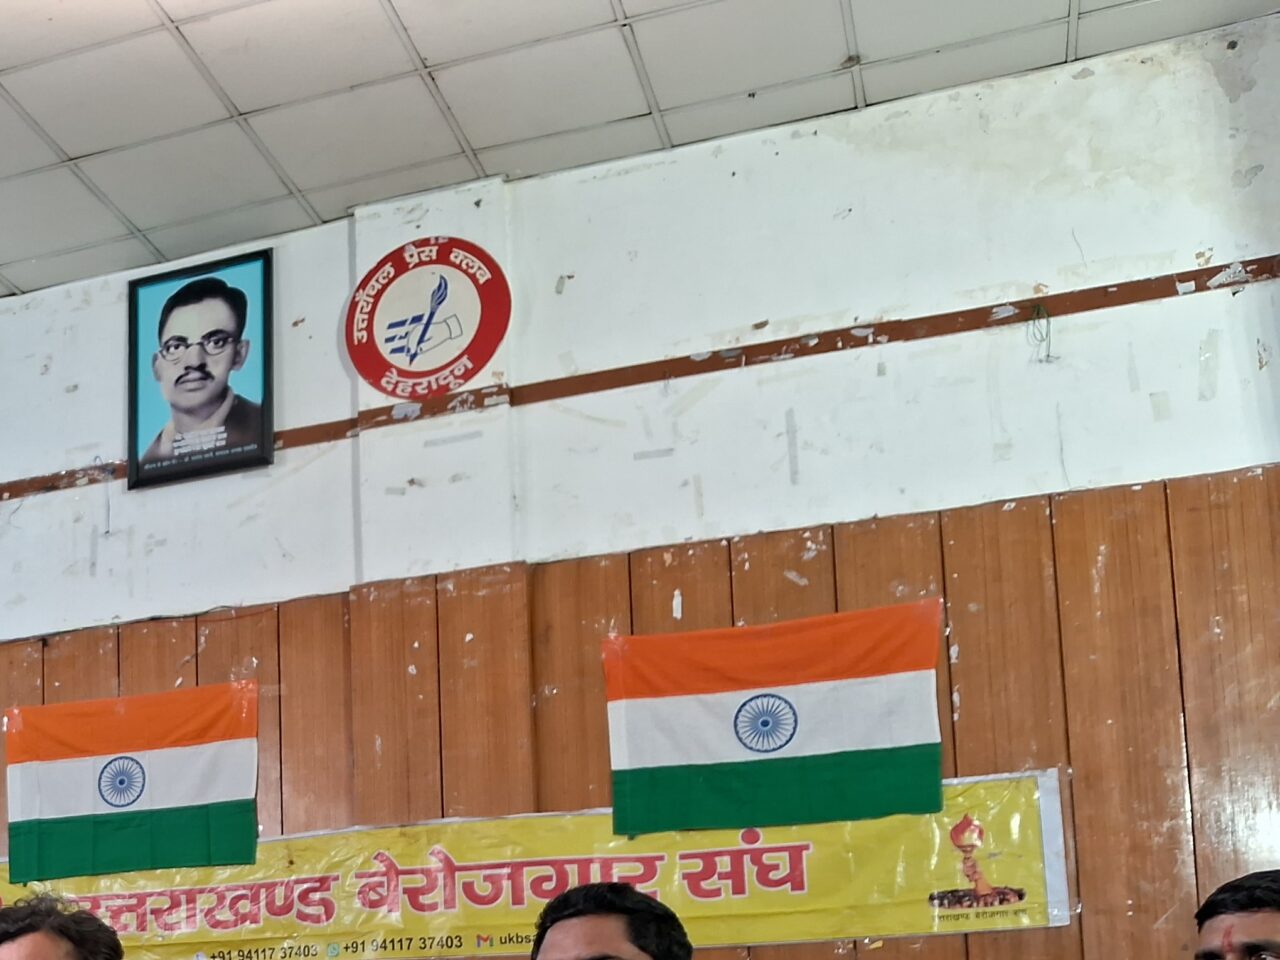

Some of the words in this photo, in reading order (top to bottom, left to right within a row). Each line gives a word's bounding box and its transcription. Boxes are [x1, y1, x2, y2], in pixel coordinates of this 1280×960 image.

[449, 248, 492, 285] क्लब
[380, 355, 474, 396] देहरादून
[354, 846, 666, 914] बेरोजगार
[681, 828, 811, 897] संघ
[280, 944, 319, 959] 37403
[343, 940, 366, 954] +91
[371, 937, 413, 952] 94117
[419, 935, 464, 950] 37403
